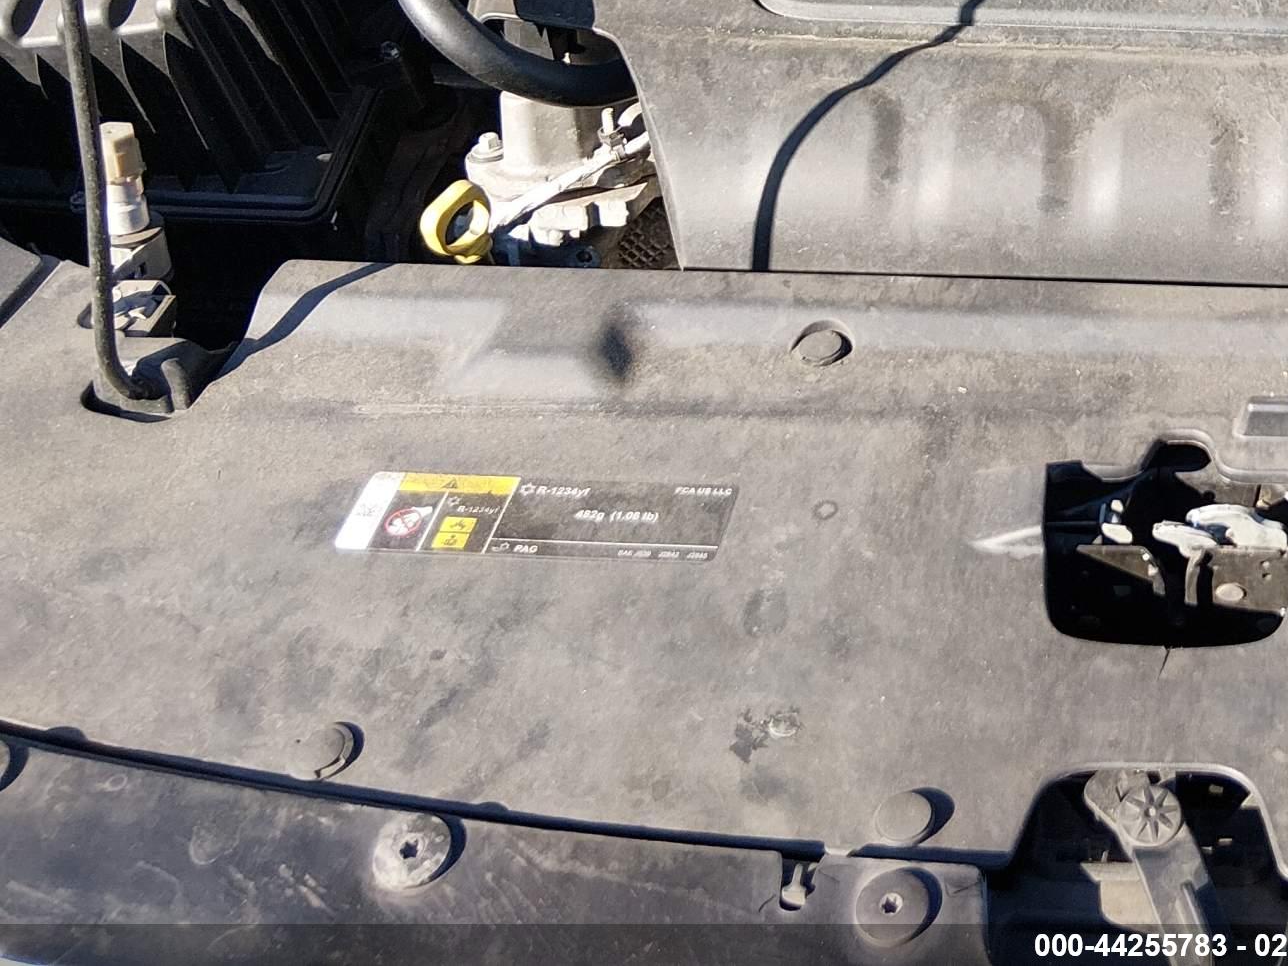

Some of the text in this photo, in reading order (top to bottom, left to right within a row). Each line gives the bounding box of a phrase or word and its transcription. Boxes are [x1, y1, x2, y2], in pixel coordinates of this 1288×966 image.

[535, 485, 592, 499] R-1234yf
[673, 486, 733, 496] FCA US LLC
[641, 511, 660, 523] lb)
[512, 544, 539, 554] PAG
